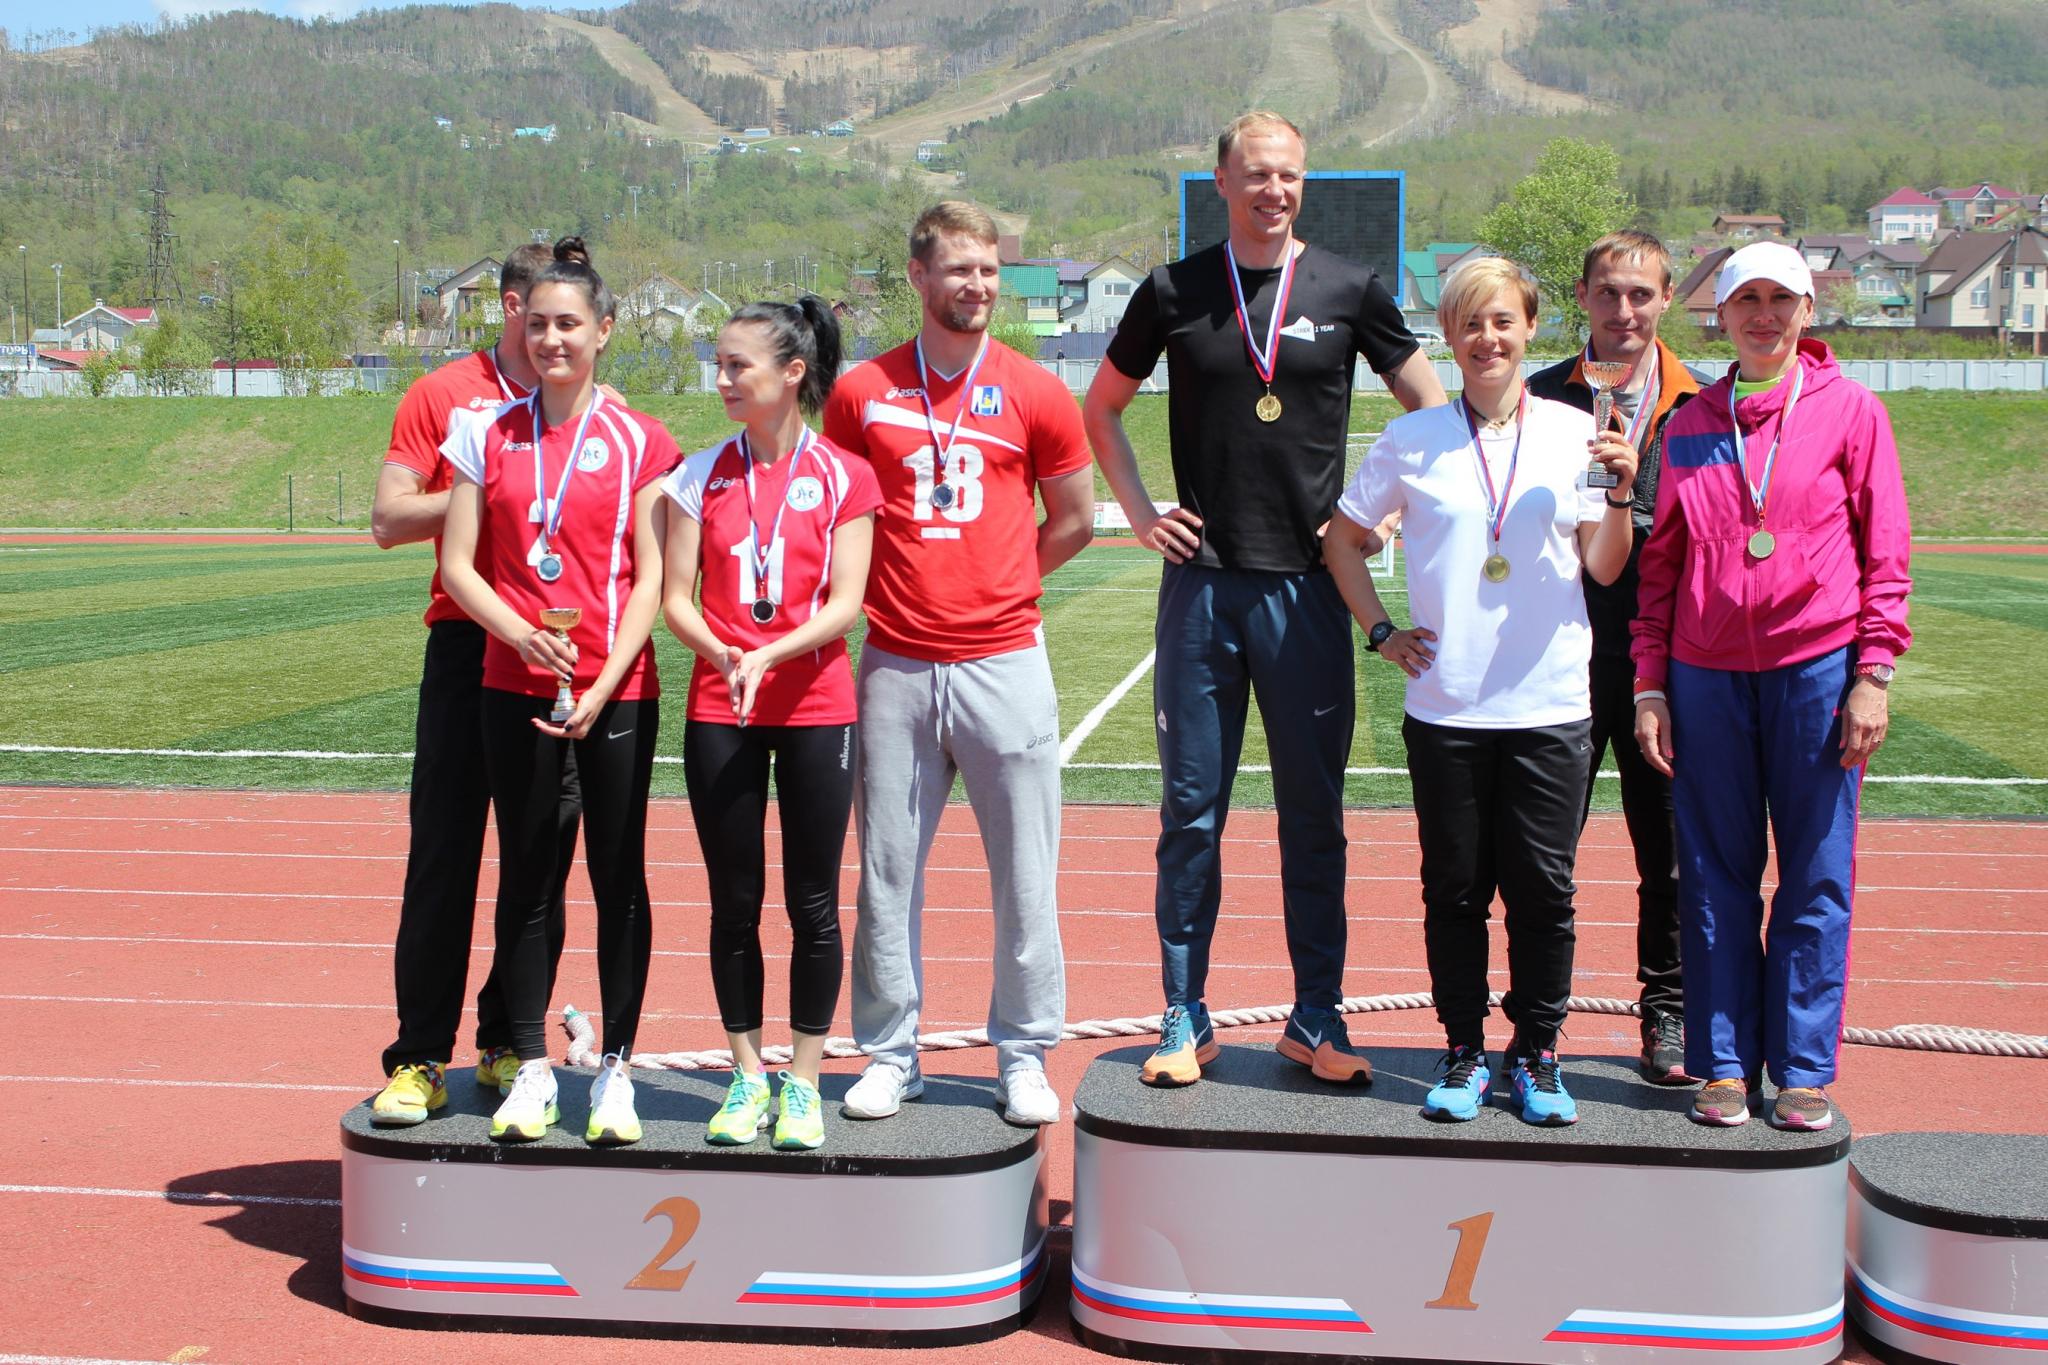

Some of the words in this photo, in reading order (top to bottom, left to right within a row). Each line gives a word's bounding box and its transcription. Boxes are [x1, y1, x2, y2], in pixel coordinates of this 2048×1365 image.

[1320, 324, 1335, 332] YEAR
[902, 444, 984, 523] 18
[730, 536, 785, 605] 11
[623, 1196, 701, 1291] 2
[1424, 1211, 1494, 1311] 1
